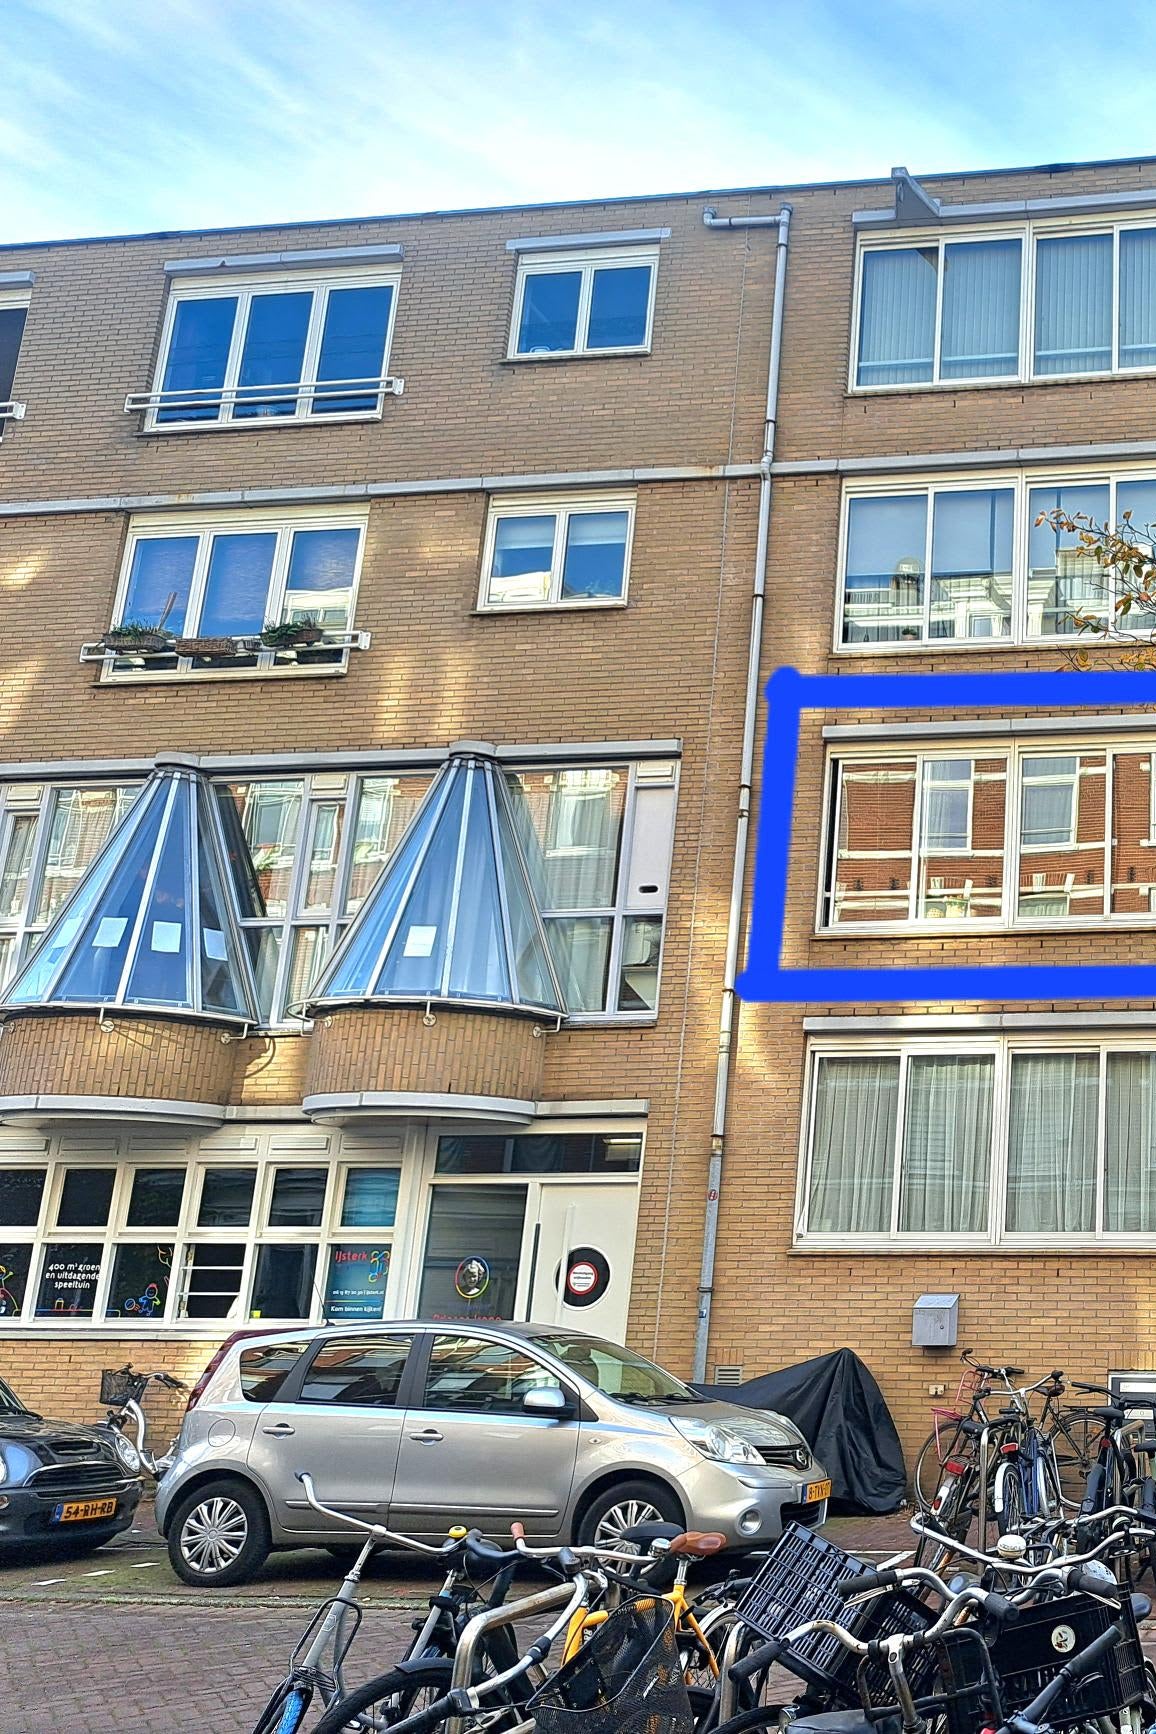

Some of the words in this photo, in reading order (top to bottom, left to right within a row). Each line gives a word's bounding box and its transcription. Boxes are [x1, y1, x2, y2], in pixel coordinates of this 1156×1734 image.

[78, 1264, 100, 1272] groen
[57, 1271, 100, 1280] uitdagende
[54, 1280, 90, 1290] speeltuin
[64, 1502, 114, 1519] 54-RH-RB
